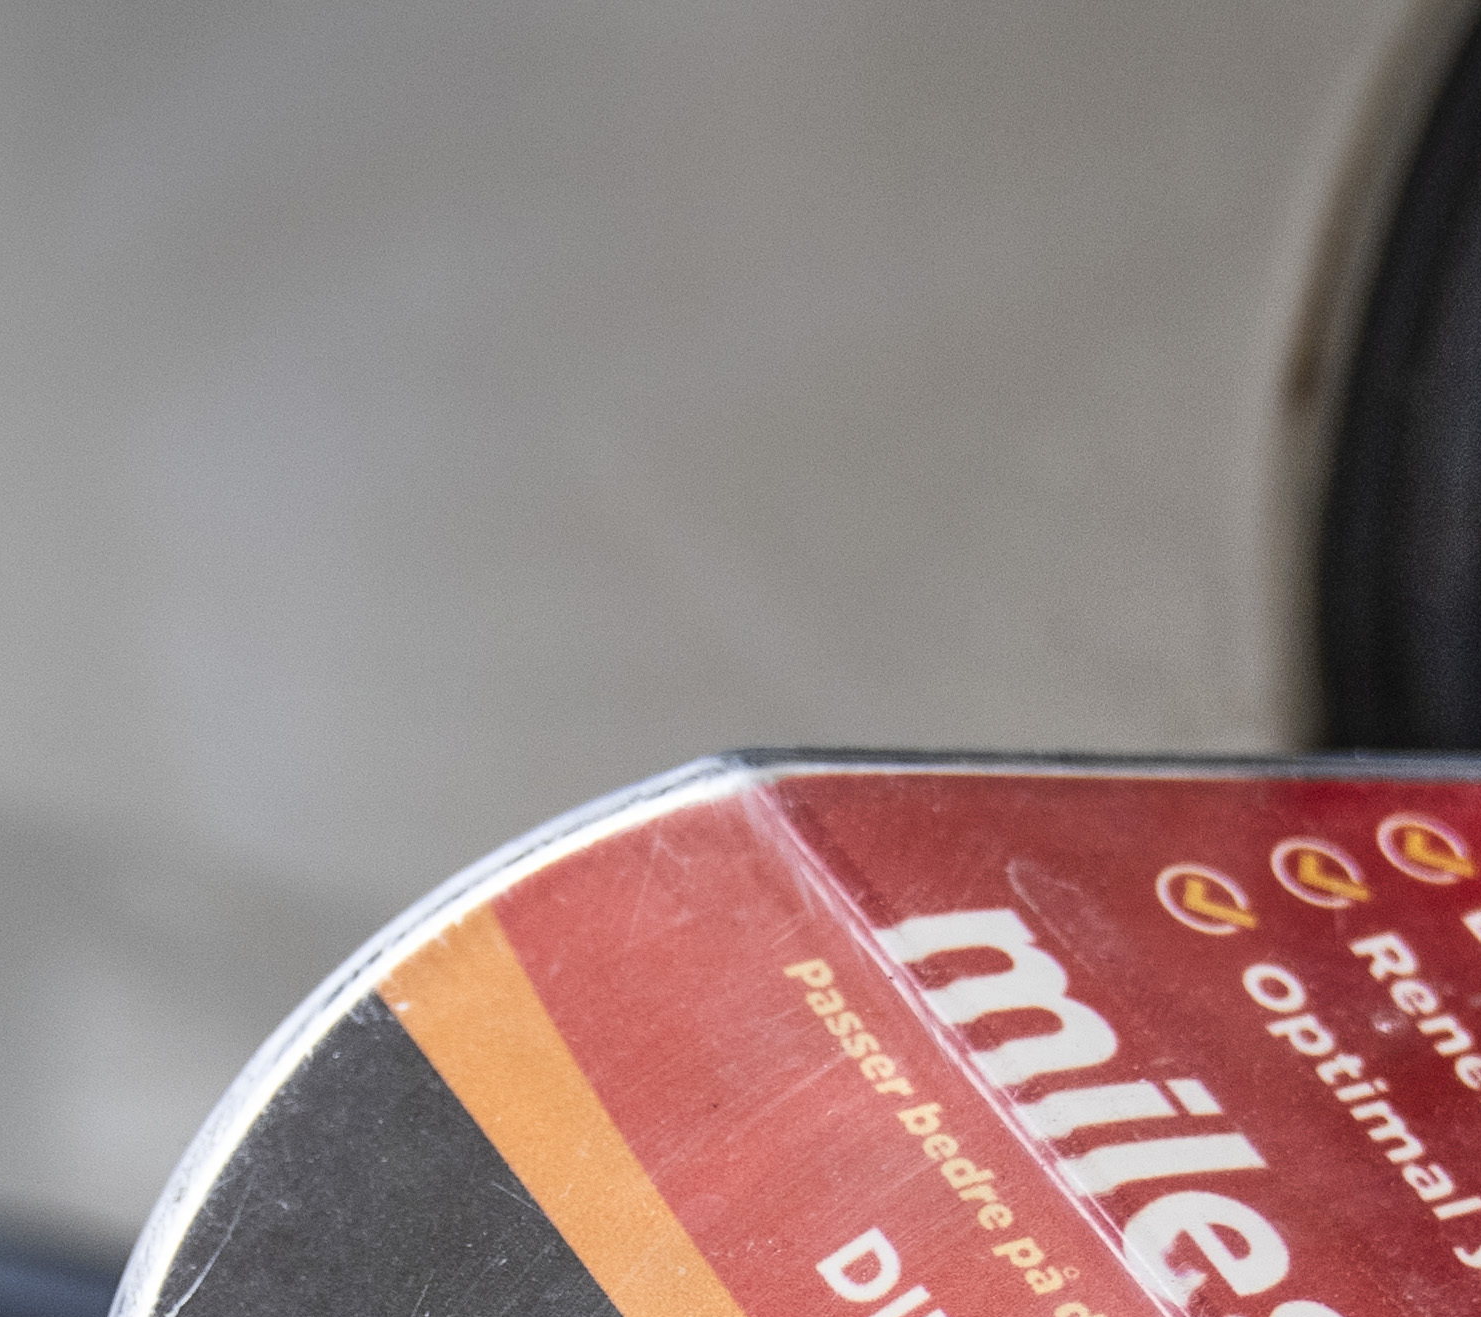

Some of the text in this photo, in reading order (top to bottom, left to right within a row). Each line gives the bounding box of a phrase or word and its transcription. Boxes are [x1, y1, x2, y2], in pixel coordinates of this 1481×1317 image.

[785, 961, 913, 1096] Passer
[899, 1103, 1012, 1229] bedre
[993, 1235, 1079, 1295] på
